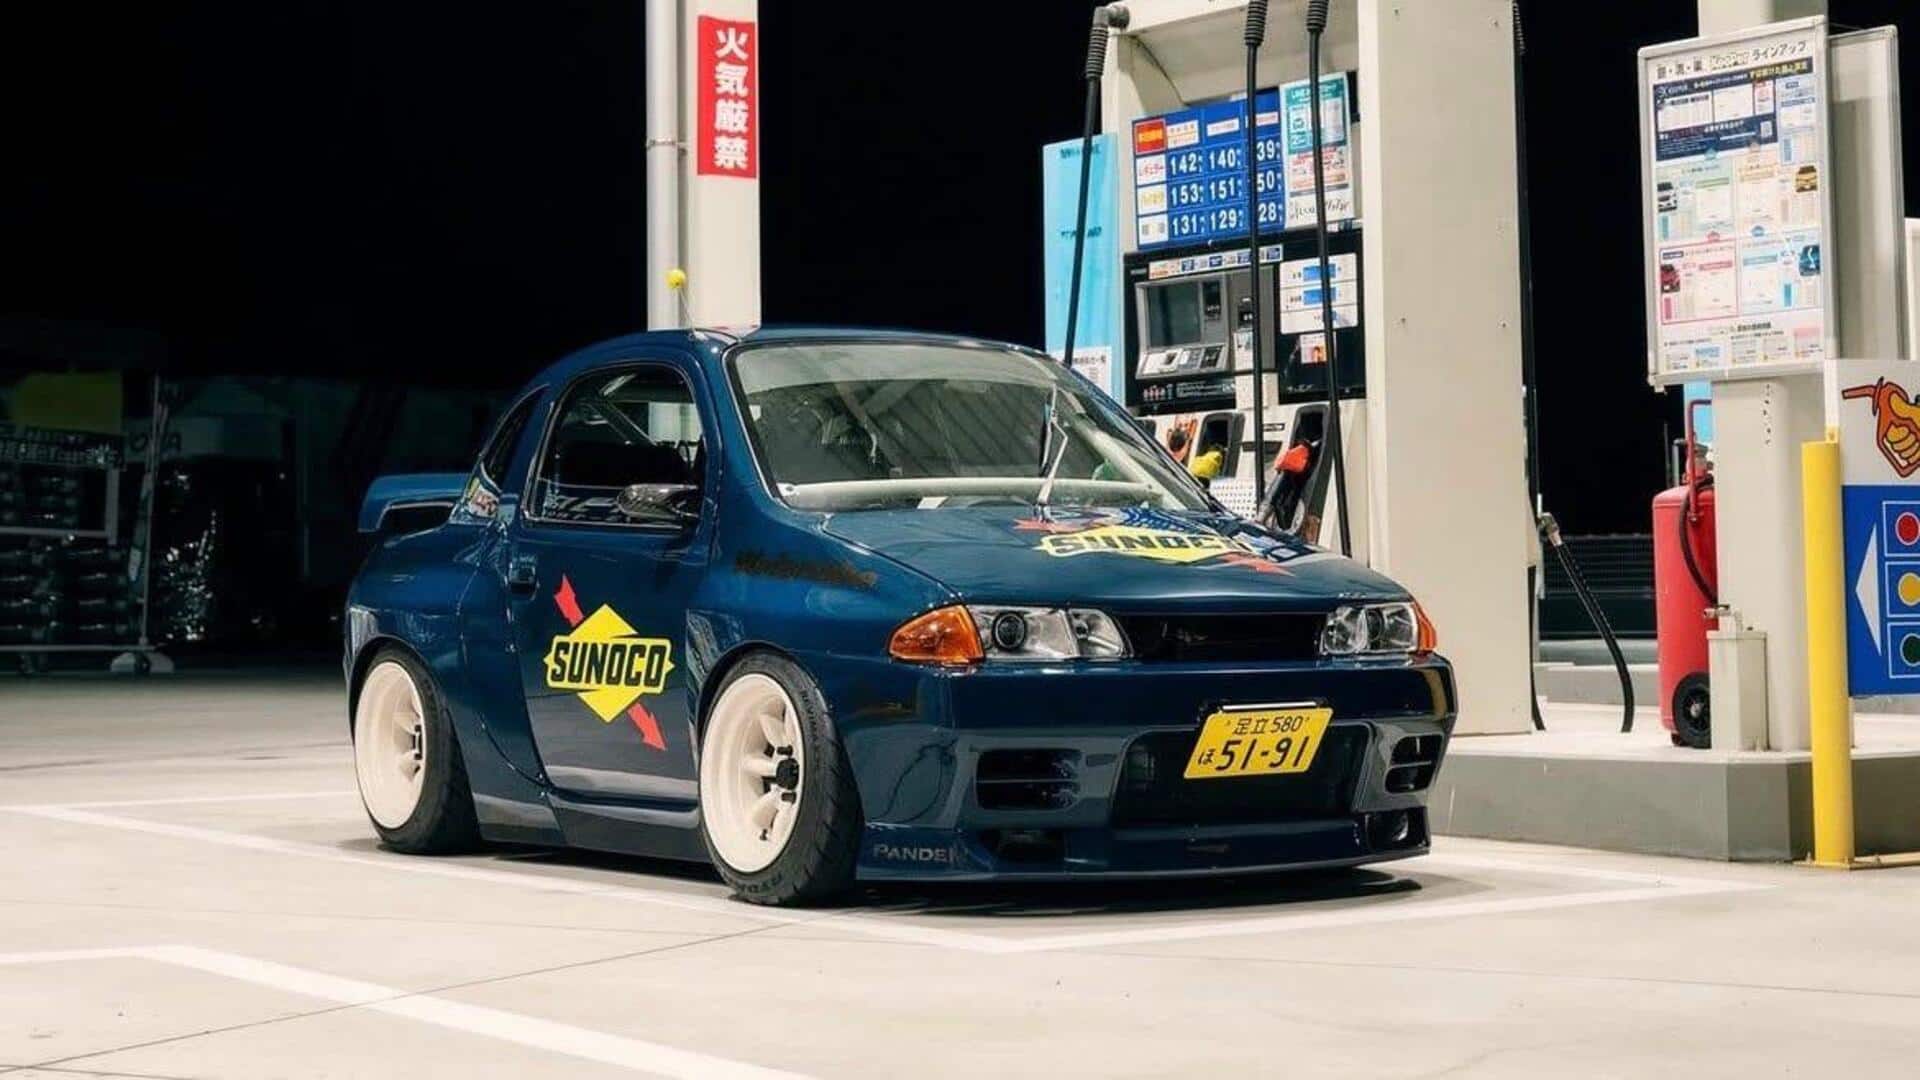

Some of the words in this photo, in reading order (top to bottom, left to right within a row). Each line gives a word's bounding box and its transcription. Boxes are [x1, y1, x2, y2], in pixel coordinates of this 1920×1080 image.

[1753, 40, 1807, 61] ラインアップ
[714, 28, 749, 170] 火気厳禁
[1170, 152, 1198, 176] 142
[1208, 148, 1237, 170] 140
[1255, 139, 1275, 161] 39
[1171, 183, 1199, 205] 153
[1209, 177, 1236, 200] 151
[1255, 170, 1275, 192] 50
[1172, 214, 1198, 236] 131
[1210, 208, 1238, 231] 129
[1257, 203, 1277, 222] 28
[550, 641, 667, 688] SUNOCO
[1232, 718, 1268, 736] 足立
[1270, 716, 1303, 733] 580
[1197, 748, 1216, 765] ほ
[1216, 736, 1310, 771] 51-91
